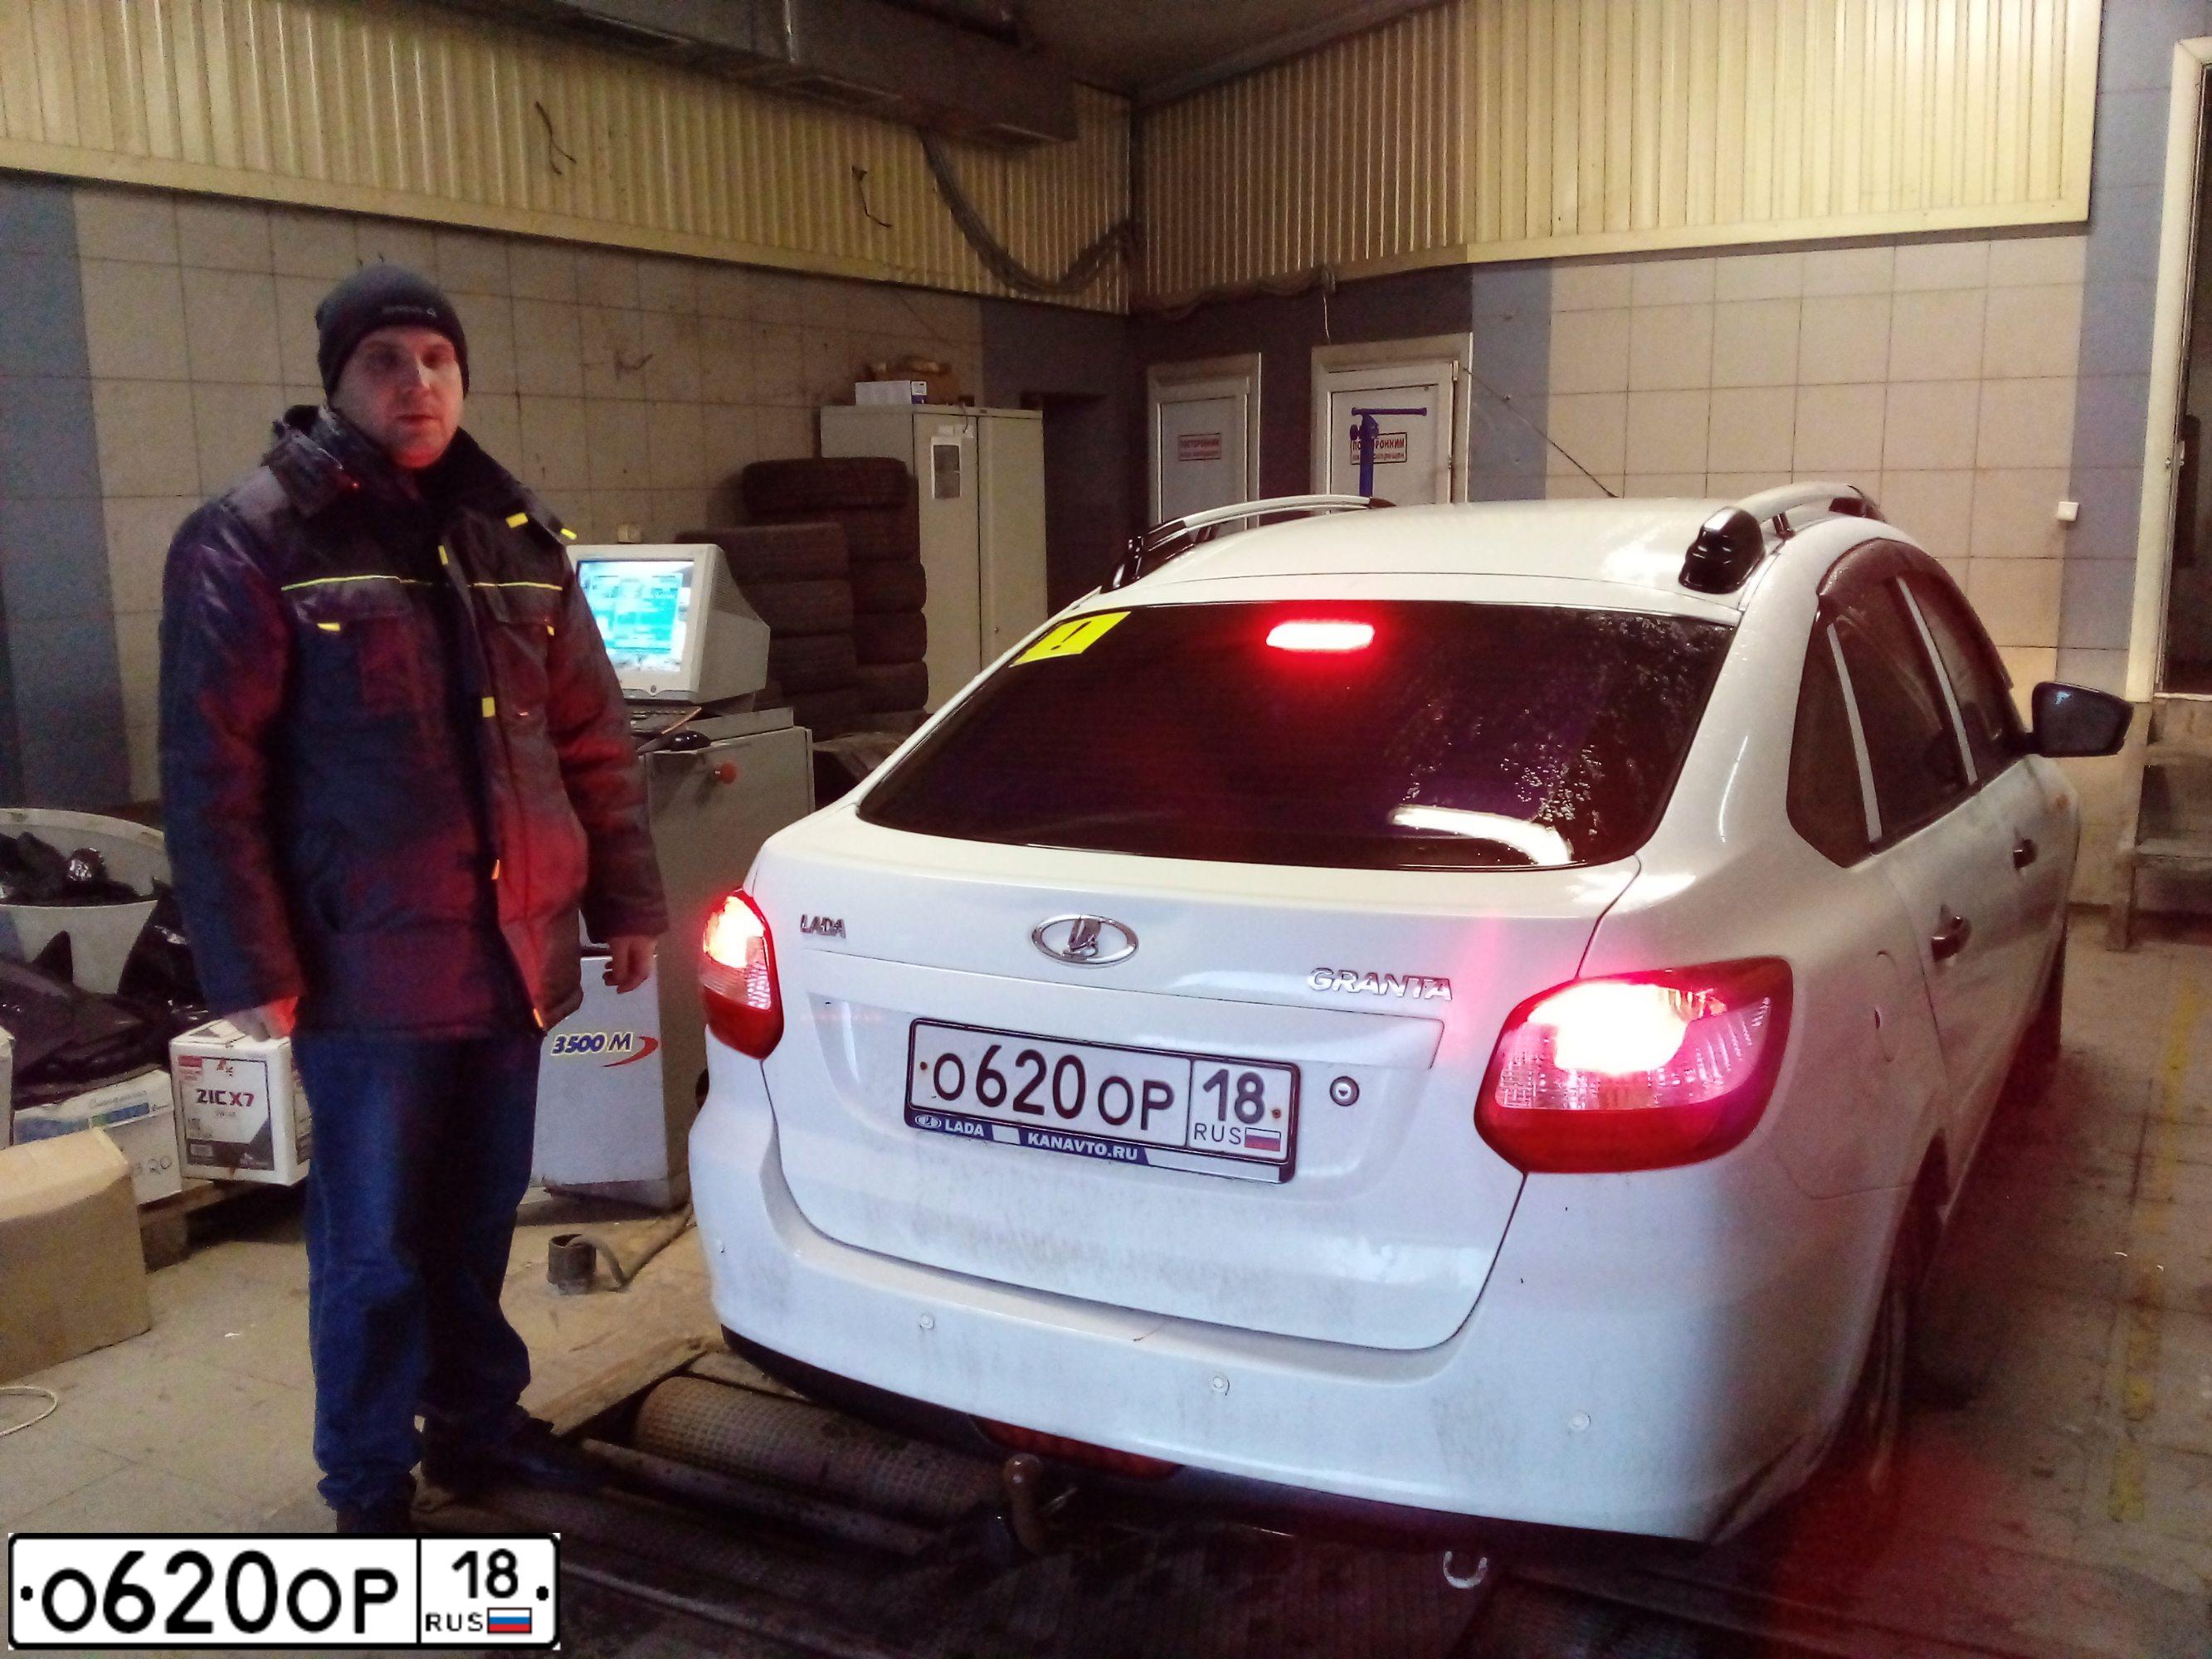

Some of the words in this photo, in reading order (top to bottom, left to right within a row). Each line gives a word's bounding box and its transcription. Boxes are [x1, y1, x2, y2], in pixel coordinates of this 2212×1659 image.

[1352, 438, 1405, 450] ПОРОННИМ
[801, 914, 846, 938] LADA
[1307, 967, 1453, 1001] GRANTA
[551, 1034, 607, 1055] 3500
[607, 1032, 633, 1052] M
[1202, 1068, 1266, 1124] 18
[944, 1119, 985, 1137] LADA
[1193, 1122, 1242, 1146] RUS
[1027, 1132, 1138, 1160] KANAVTO.RU
